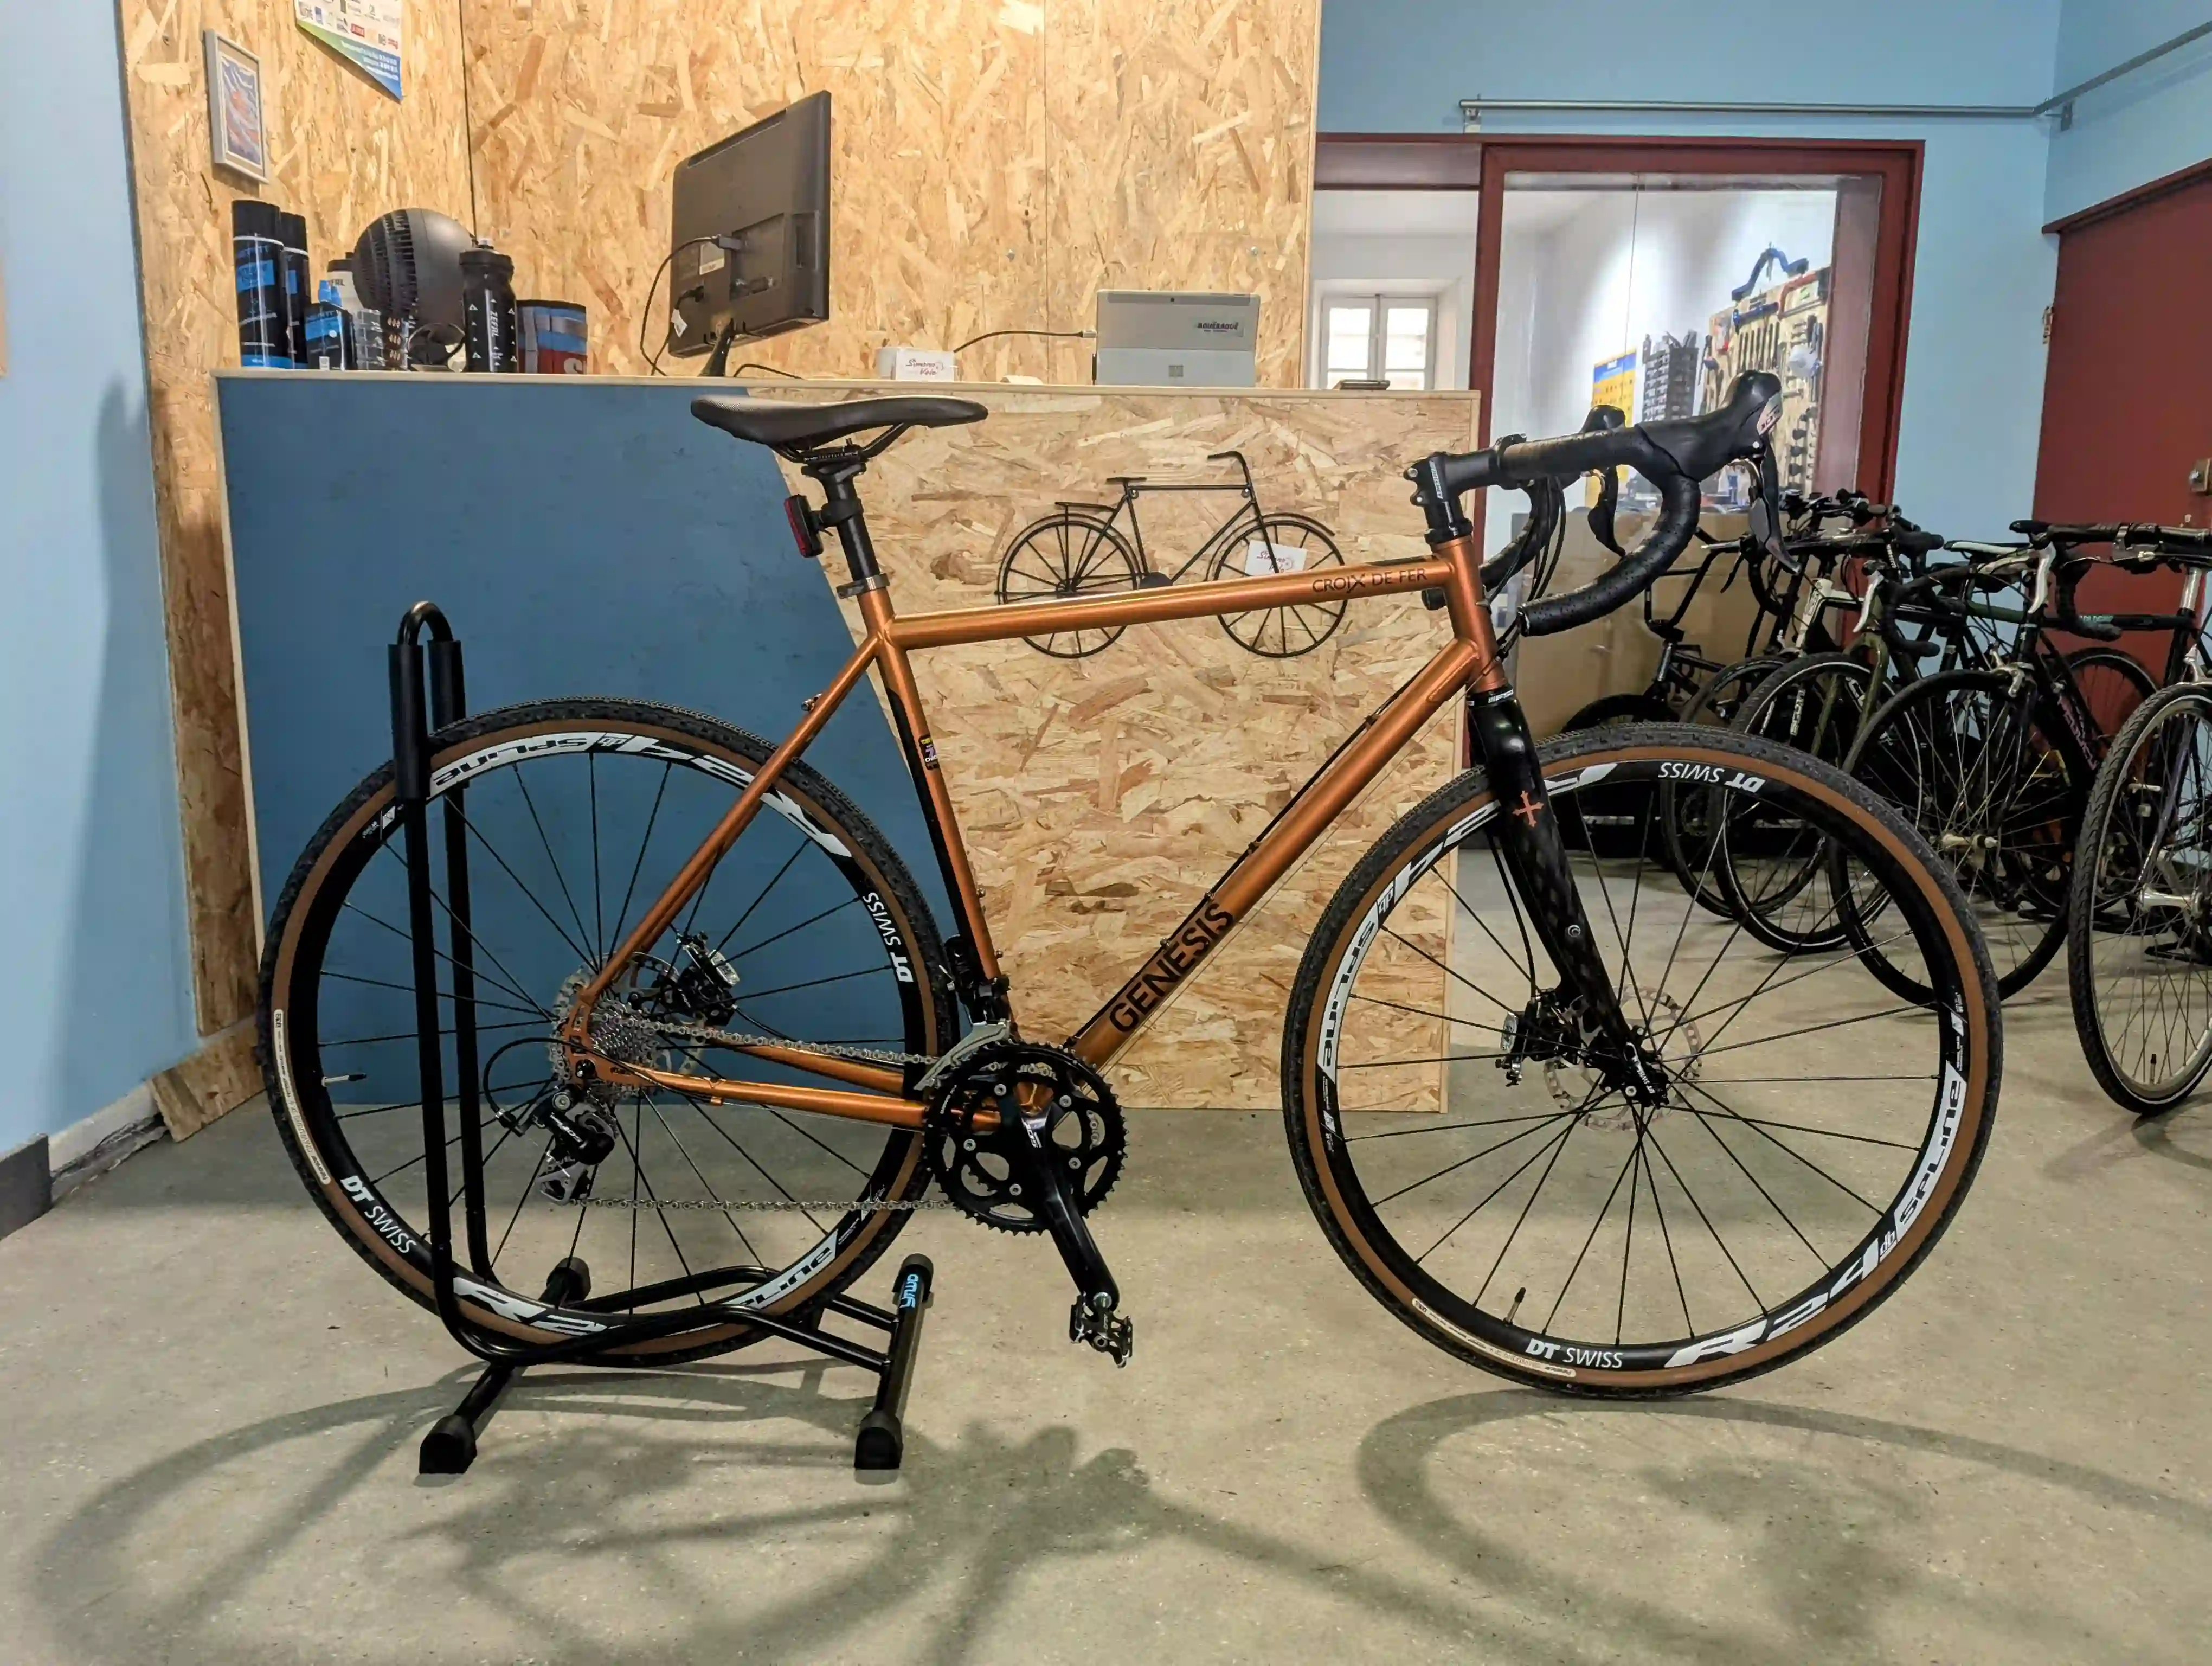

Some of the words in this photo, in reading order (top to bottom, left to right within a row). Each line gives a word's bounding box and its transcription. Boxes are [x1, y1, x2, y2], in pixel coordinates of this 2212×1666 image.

[1312, 573, 1366, 594] CROIX
[1372, 573, 1392, 586] DE
[1399, 568, 1428, 583] FER
[1658, 762, 1725, 783] SWISS
[1724, 772, 1766, 793] DT
[862, 892, 902, 946] SWISS
[890, 952, 914, 983] DT
[1109, 902, 1234, 1033] GENESIS
[340, 1175, 375, 1202] DT
[364, 1206, 417, 1253] SWISS
[1525, 1338, 1561, 1359] DT
[1562, 1347, 1624, 1368] SWISS
